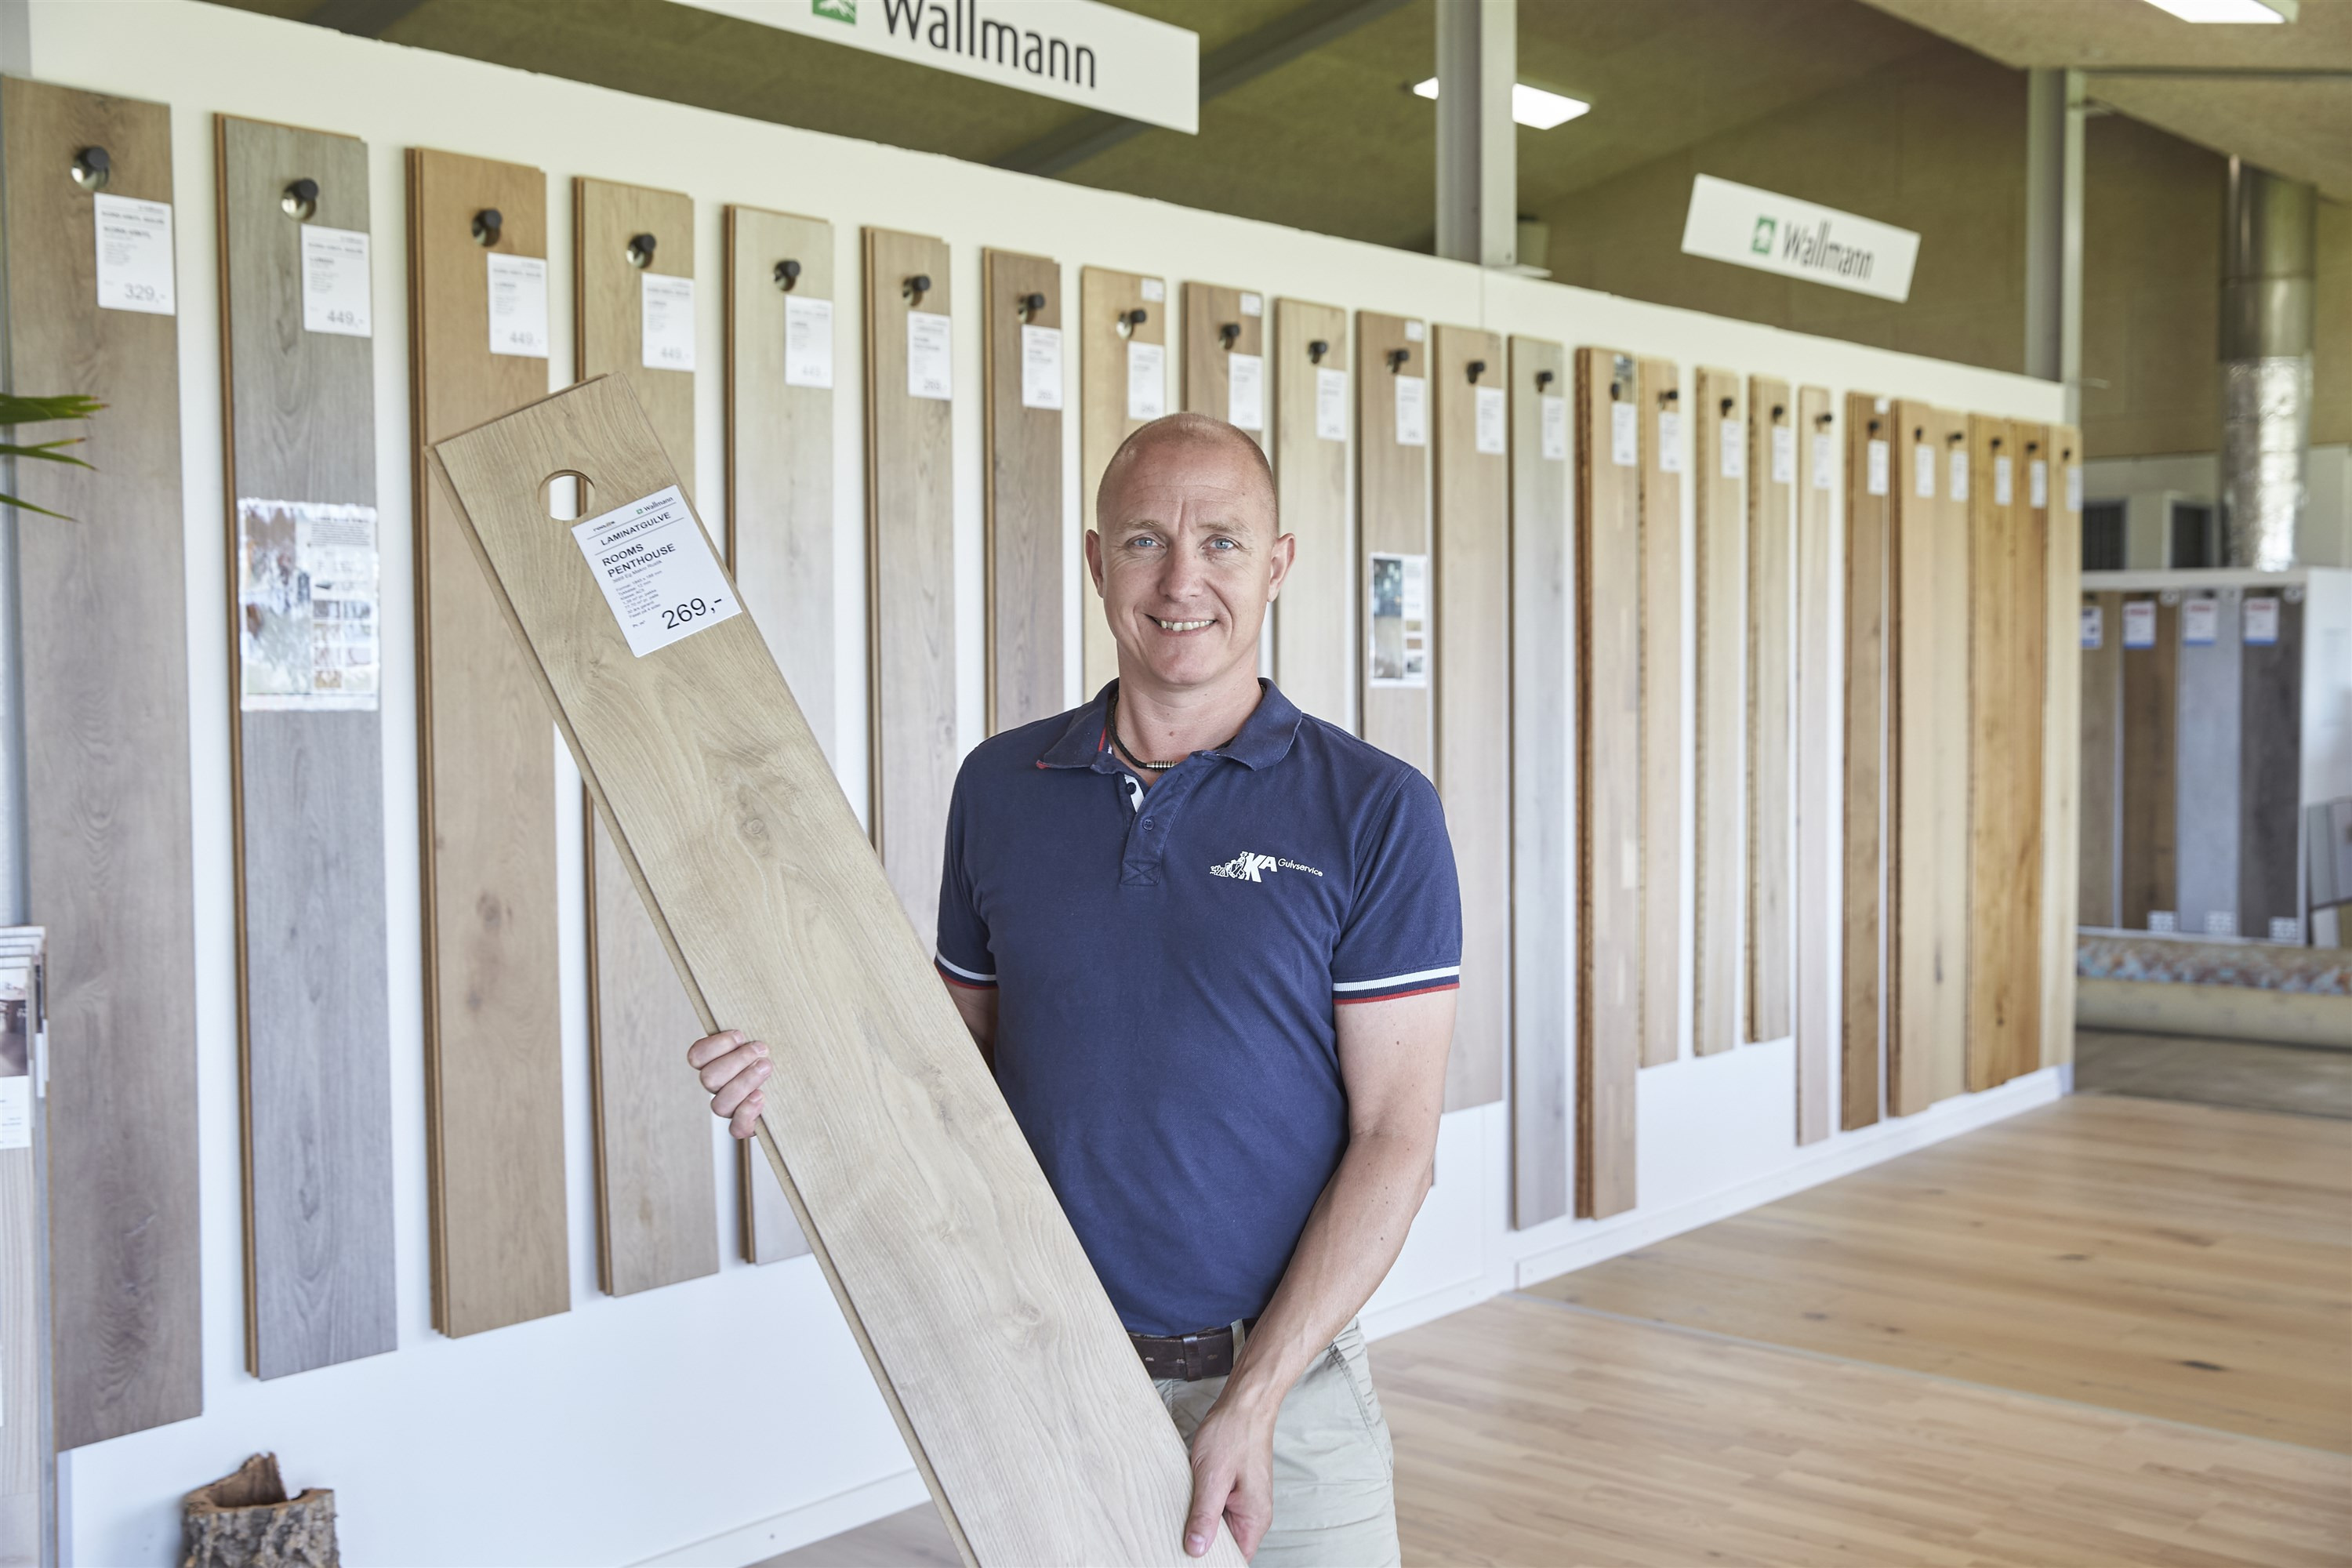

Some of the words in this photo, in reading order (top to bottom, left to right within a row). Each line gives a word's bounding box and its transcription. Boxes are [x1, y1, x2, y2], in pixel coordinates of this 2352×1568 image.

[883, 0, 1096, 89] Wallmann
[1783, 220, 1874, 280] Wallmann
[644, 496, 673, 511] Wallmann
[600, 511, 671, 546] LAMINATGULVE
[601, 543, 644, 566] ROOMS
[607, 543, 676, 577] PENTHOUSE
[662, 597, 722, 630] 269,-
[1244, 852, 1278, 883] KA
[1278, 858, 1323, 877] Gulvservice
